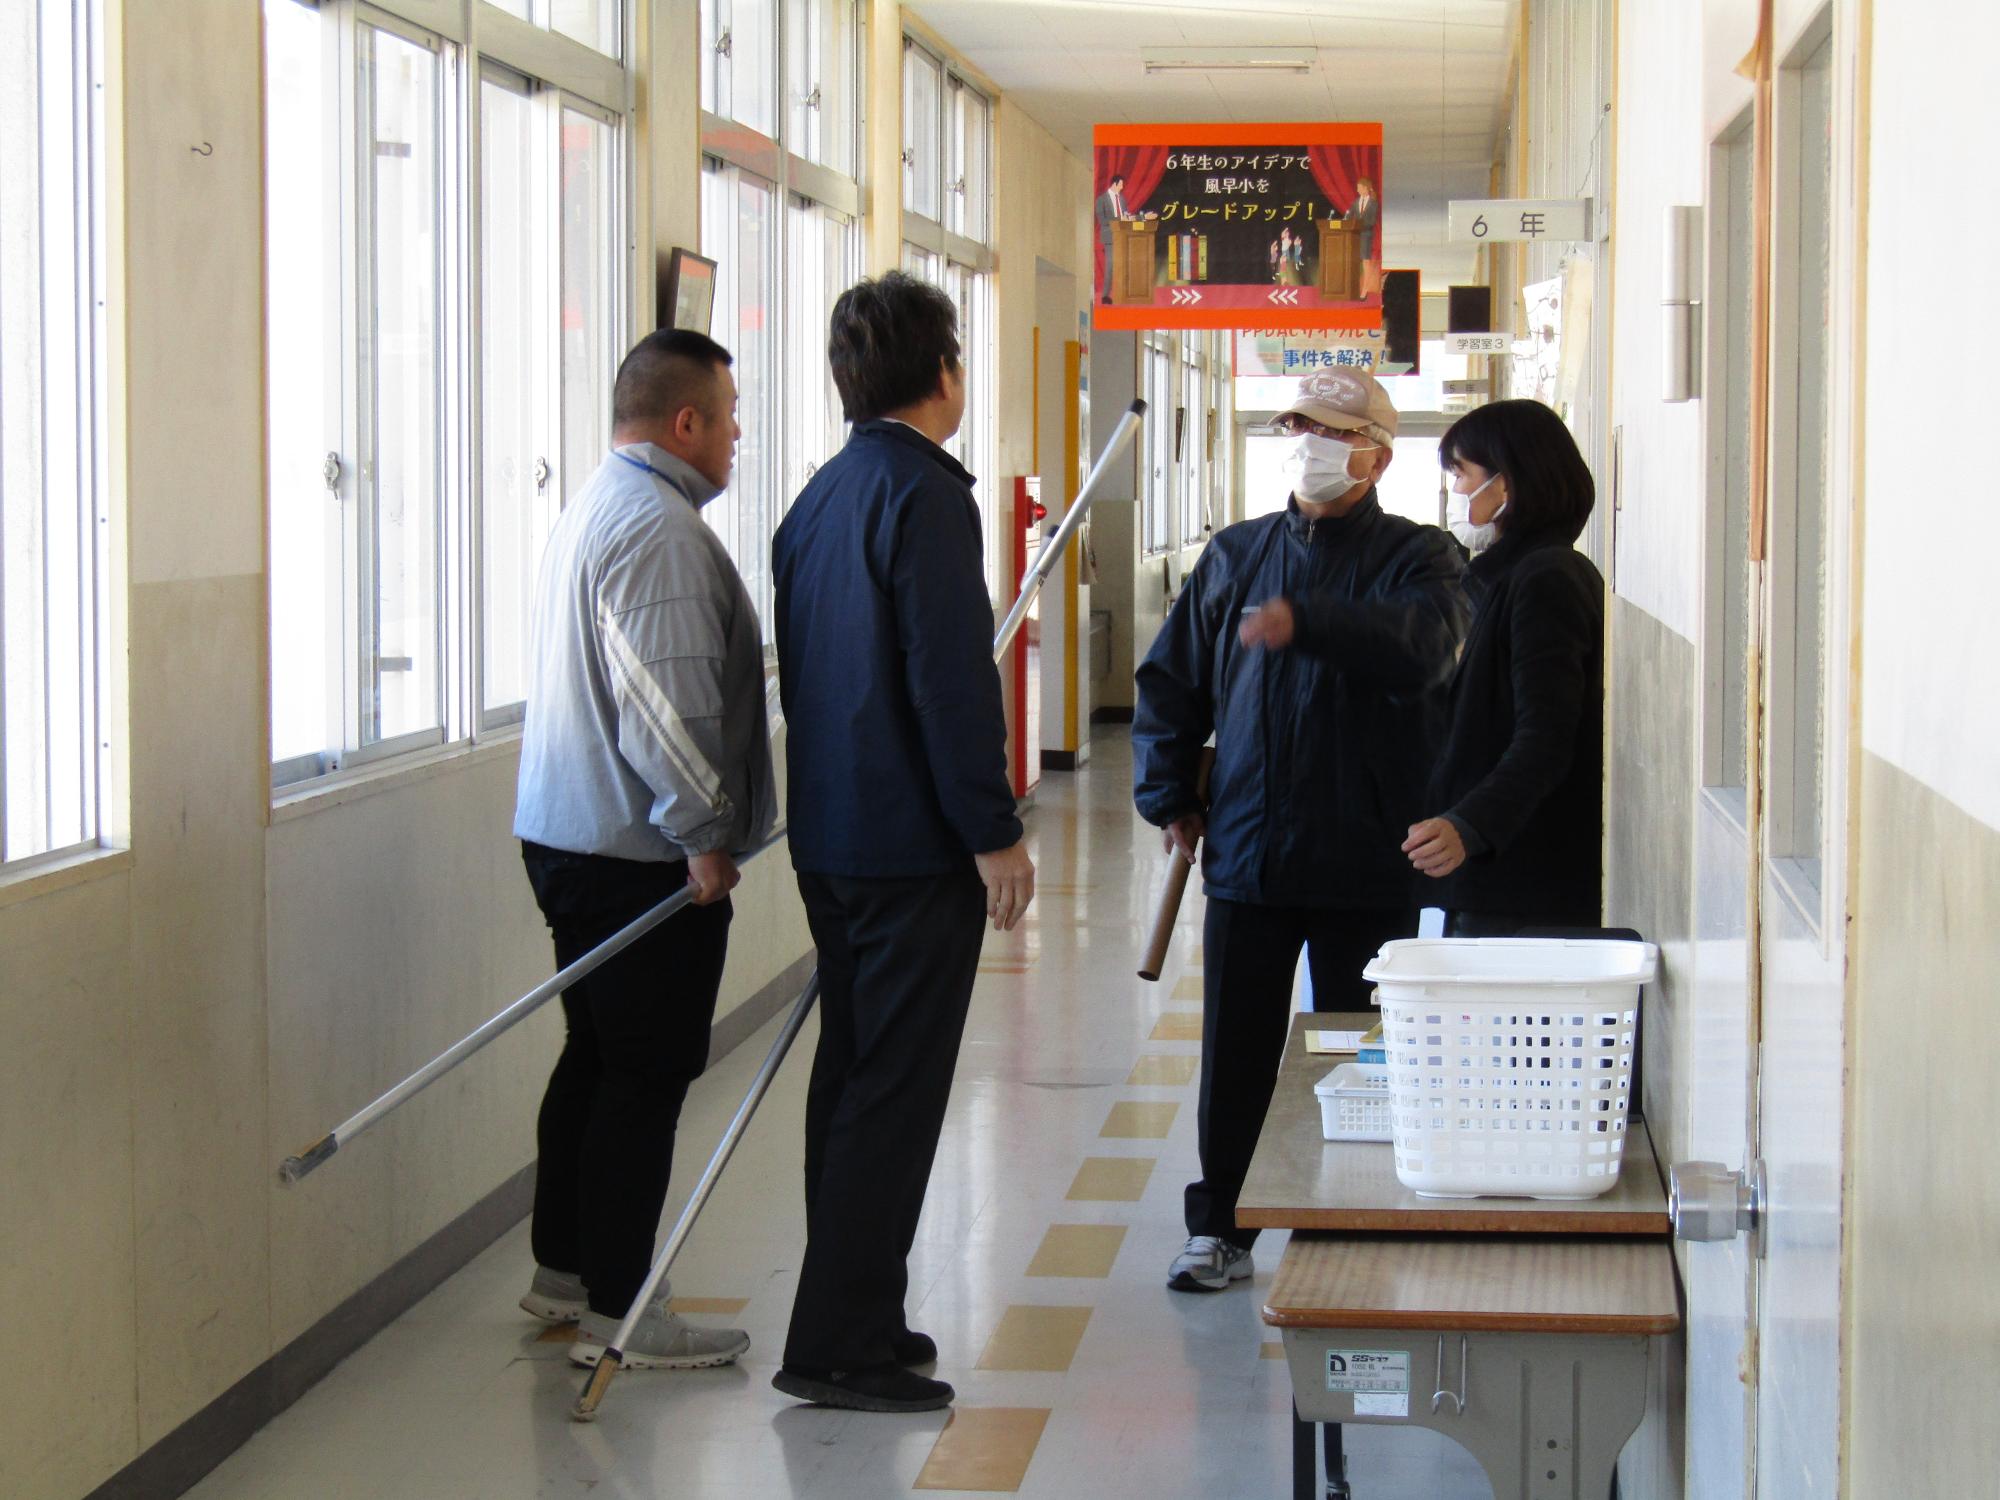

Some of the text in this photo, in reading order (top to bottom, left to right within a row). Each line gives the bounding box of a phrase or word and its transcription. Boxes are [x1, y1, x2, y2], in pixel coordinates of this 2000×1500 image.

[1166, 154, 1312, 171] 6年生のアイデアで
[1205, 178, 1270, 194] 風早小を
[1161, 201, 1314, 221] グレードアップ!
[1457, 338, 1504, 350] 学習室3
[1283, 350, 1386, 367] 事件を解決!
